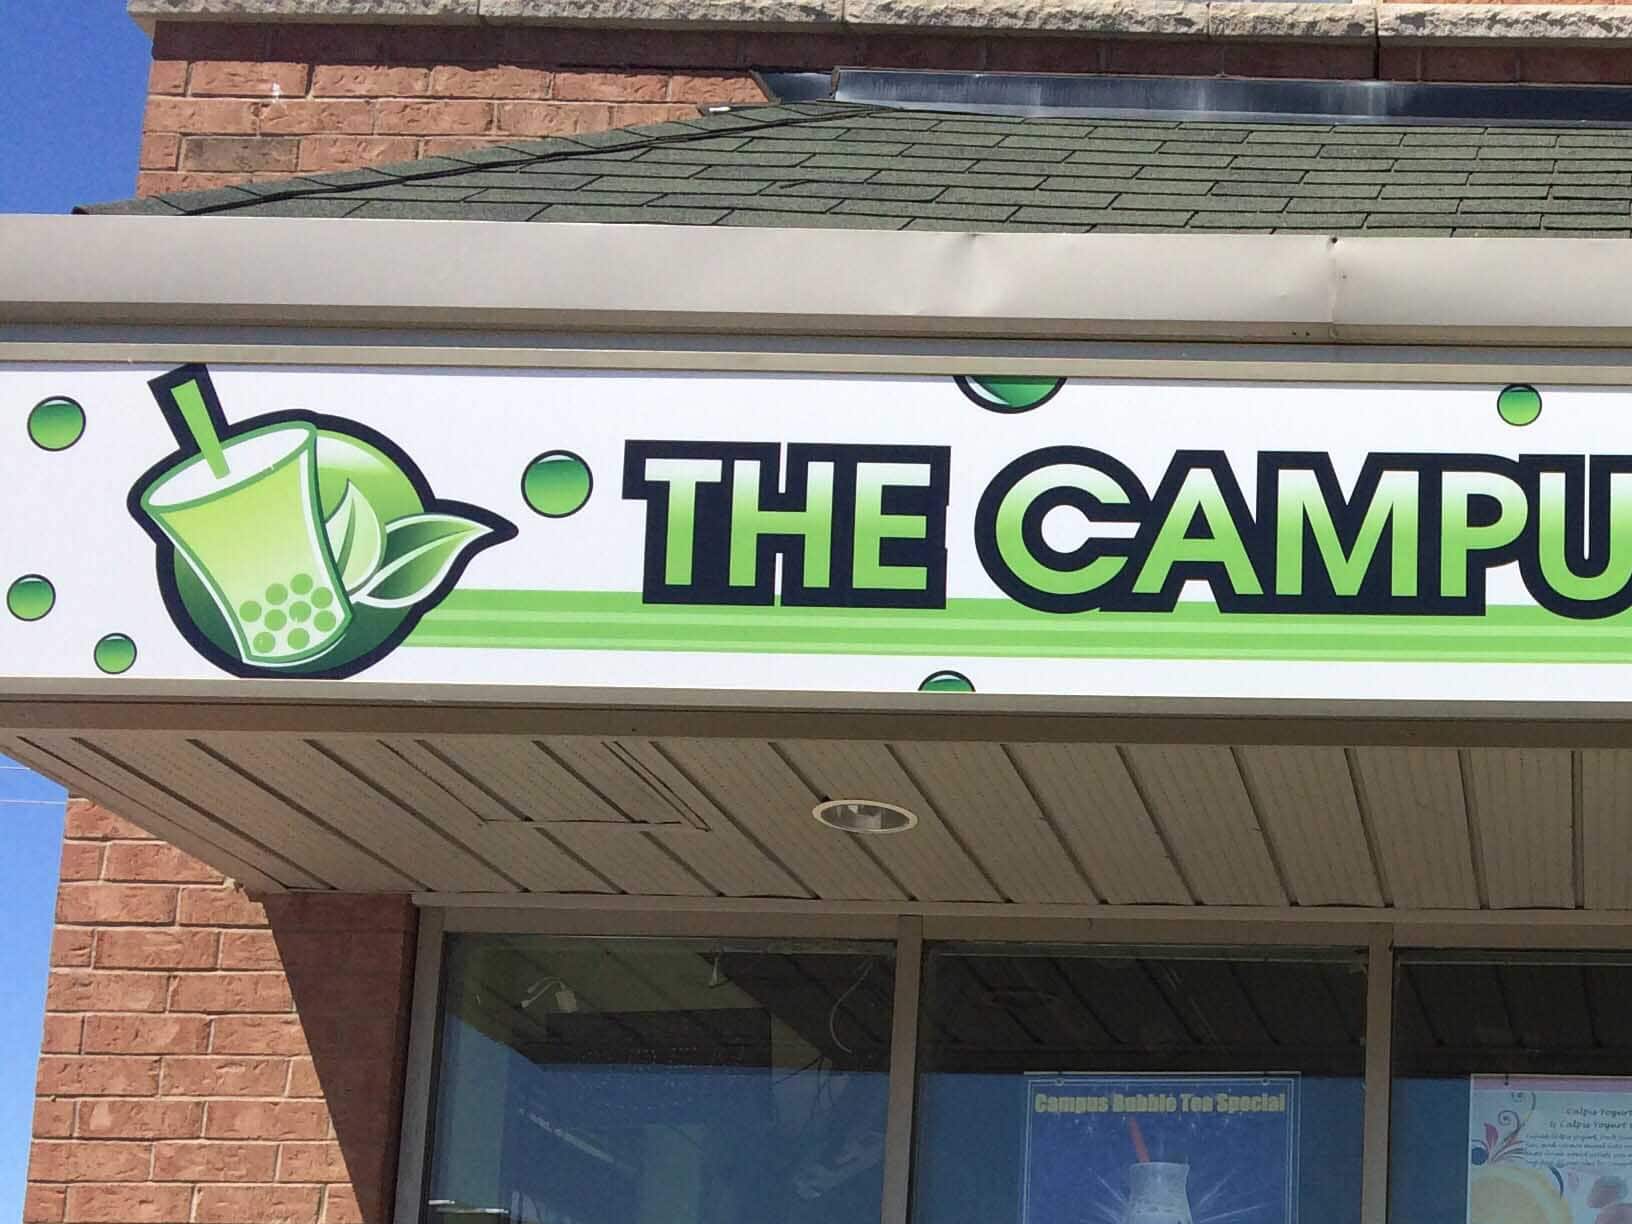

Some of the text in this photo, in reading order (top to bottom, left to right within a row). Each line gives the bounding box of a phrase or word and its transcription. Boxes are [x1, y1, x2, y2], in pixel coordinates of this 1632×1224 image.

[624, 440, 951, 608] THE
[1035, 1093, 1286, 1115] Campus Bubble Tea Special
